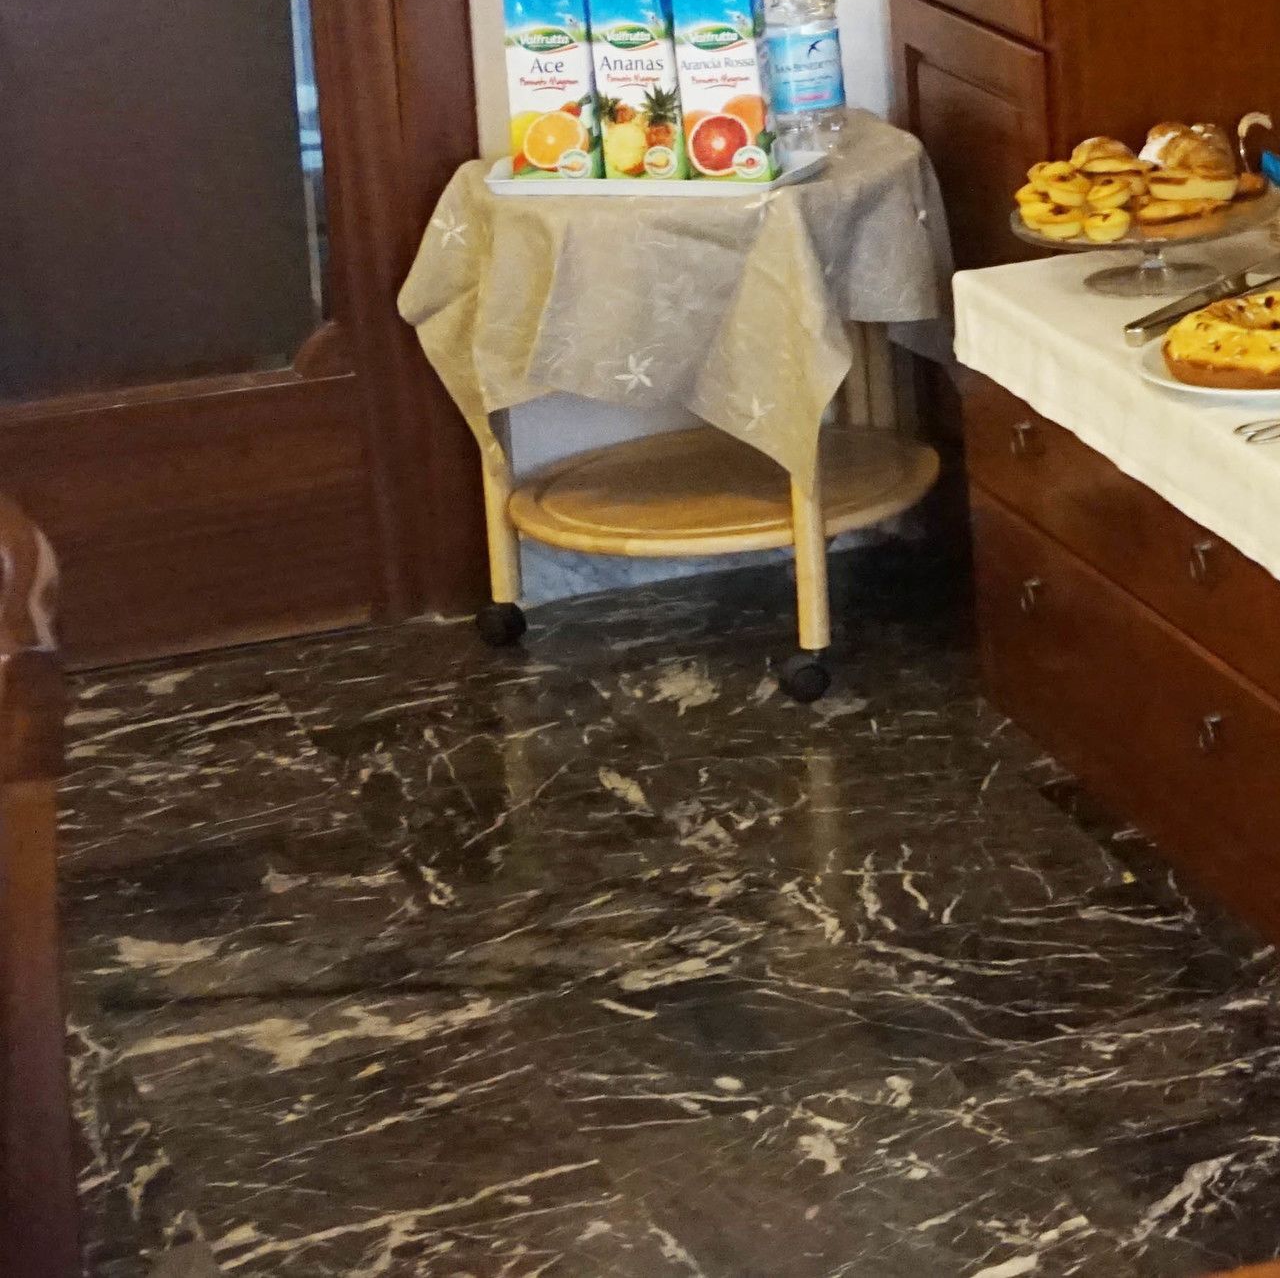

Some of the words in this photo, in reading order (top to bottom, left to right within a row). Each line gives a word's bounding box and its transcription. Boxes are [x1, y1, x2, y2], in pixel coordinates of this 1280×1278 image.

[530, 58, 565, 73] Ace
[600, 56, 665, 71] Ananas
[680, 57, 721, 71] Arancia
[724, 56, 756, 68] Rossa
